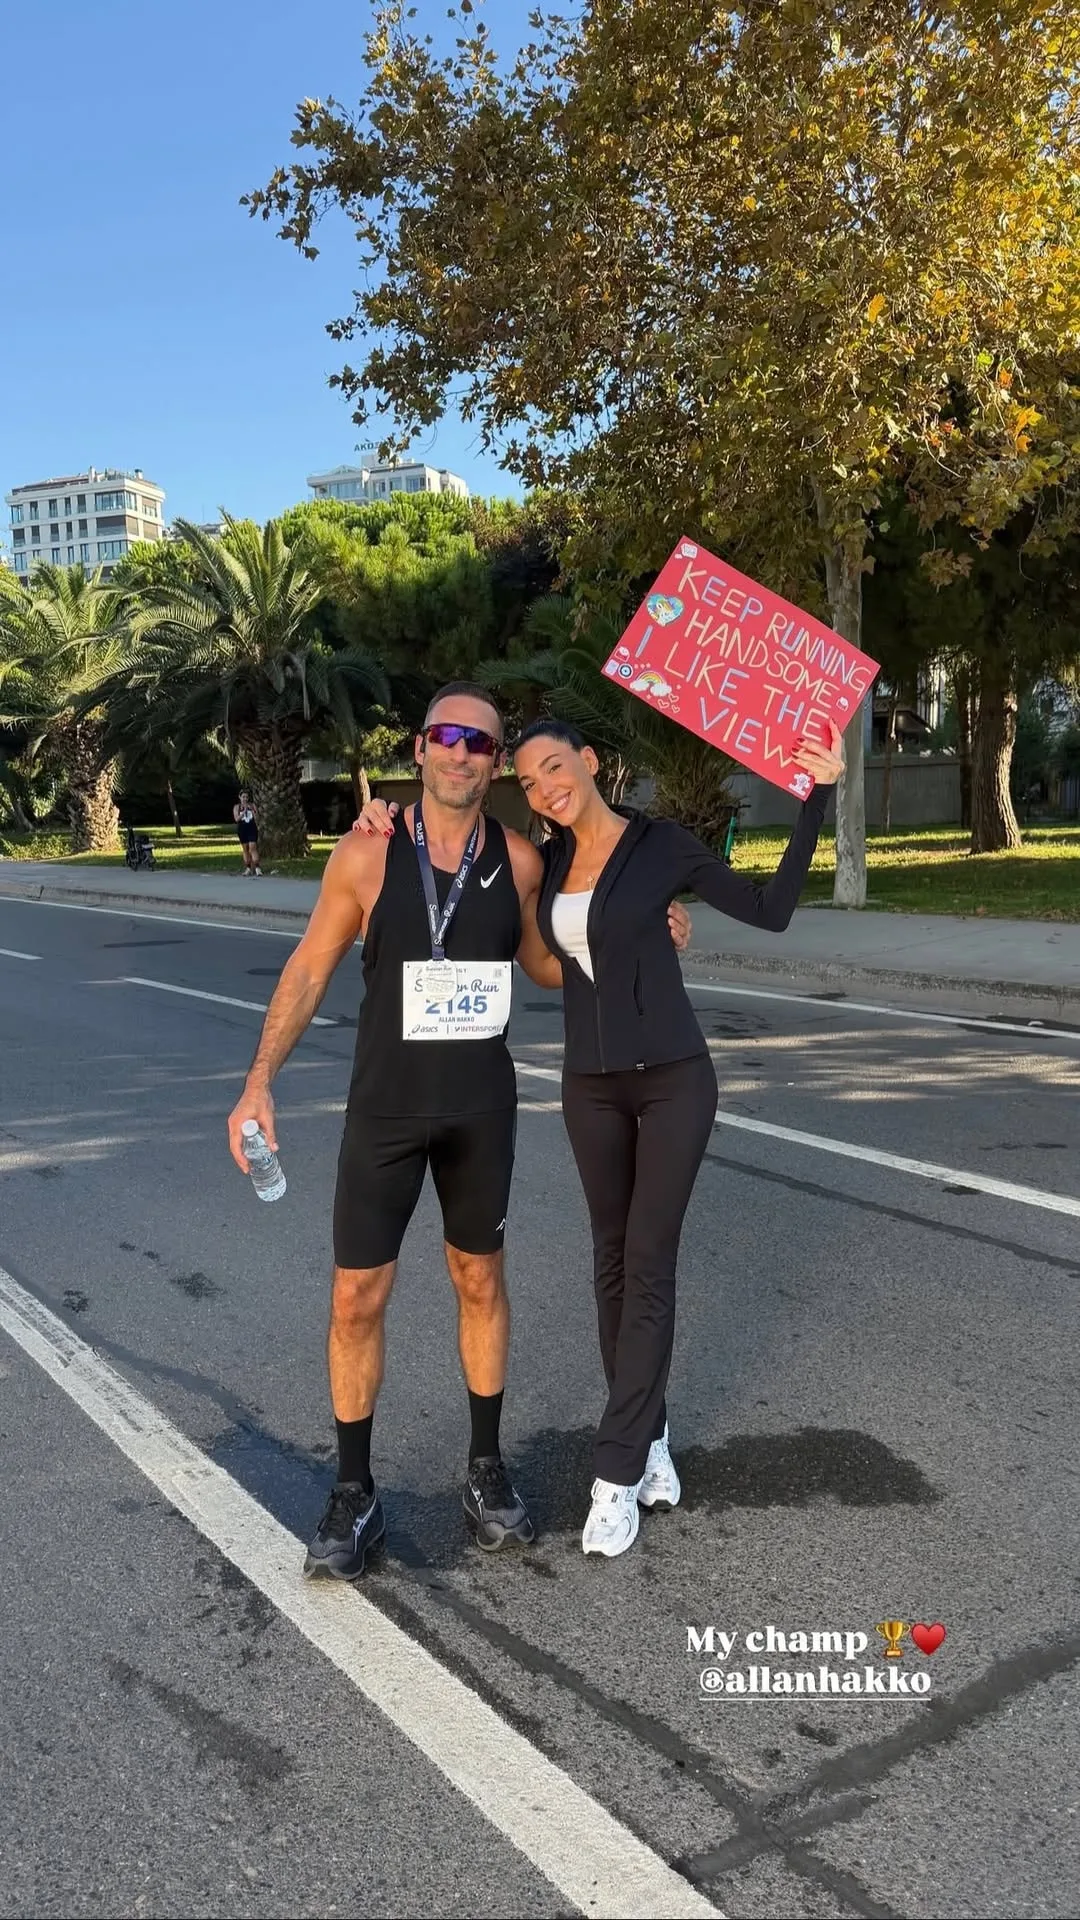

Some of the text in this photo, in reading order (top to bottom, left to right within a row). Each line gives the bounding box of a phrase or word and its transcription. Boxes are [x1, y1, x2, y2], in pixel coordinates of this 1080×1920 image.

[677, 561, 871, 698] KEEP RUNNING
[684, 609, 840, 709] HANDSOME
[635, 625, 830, 742] I LIKE THE
[700, 697, 795, 768] VIEW
[425, 995, 488, 1014] 2145
[470, 979, 500, 993] Run
